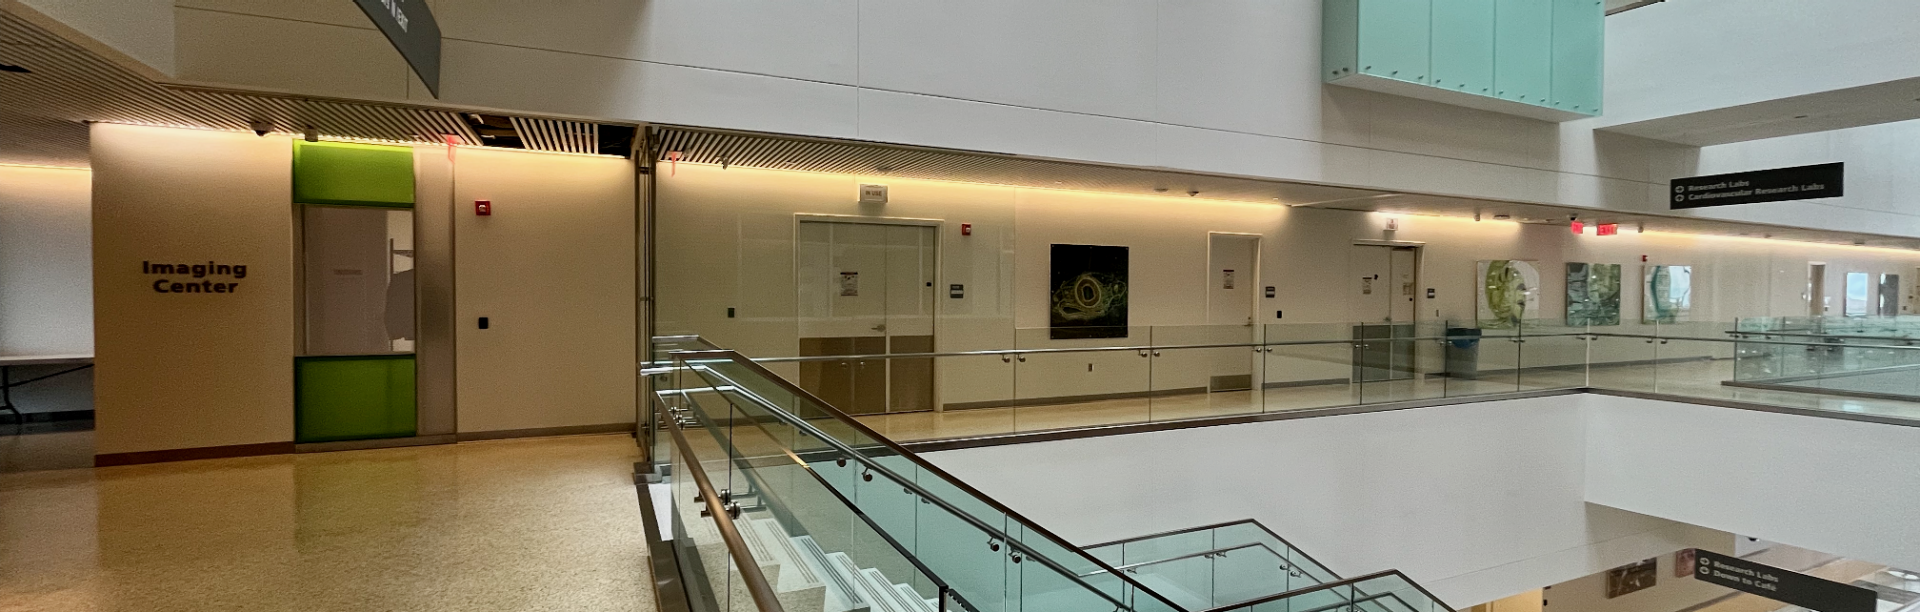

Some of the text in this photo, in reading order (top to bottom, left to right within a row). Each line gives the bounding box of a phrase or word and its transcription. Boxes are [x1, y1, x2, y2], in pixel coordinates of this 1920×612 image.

[1688, 180, 1750, 192] Research Labs
[1688, 183, 1825, 201] Cardiovascular Research Labs
[143, 260, 246, 278] Imaging
[153, 280, 238, 293] Center
[1713, 561, 1779, 583] Research Labs
[1713, 569, 1740, 582] Down
